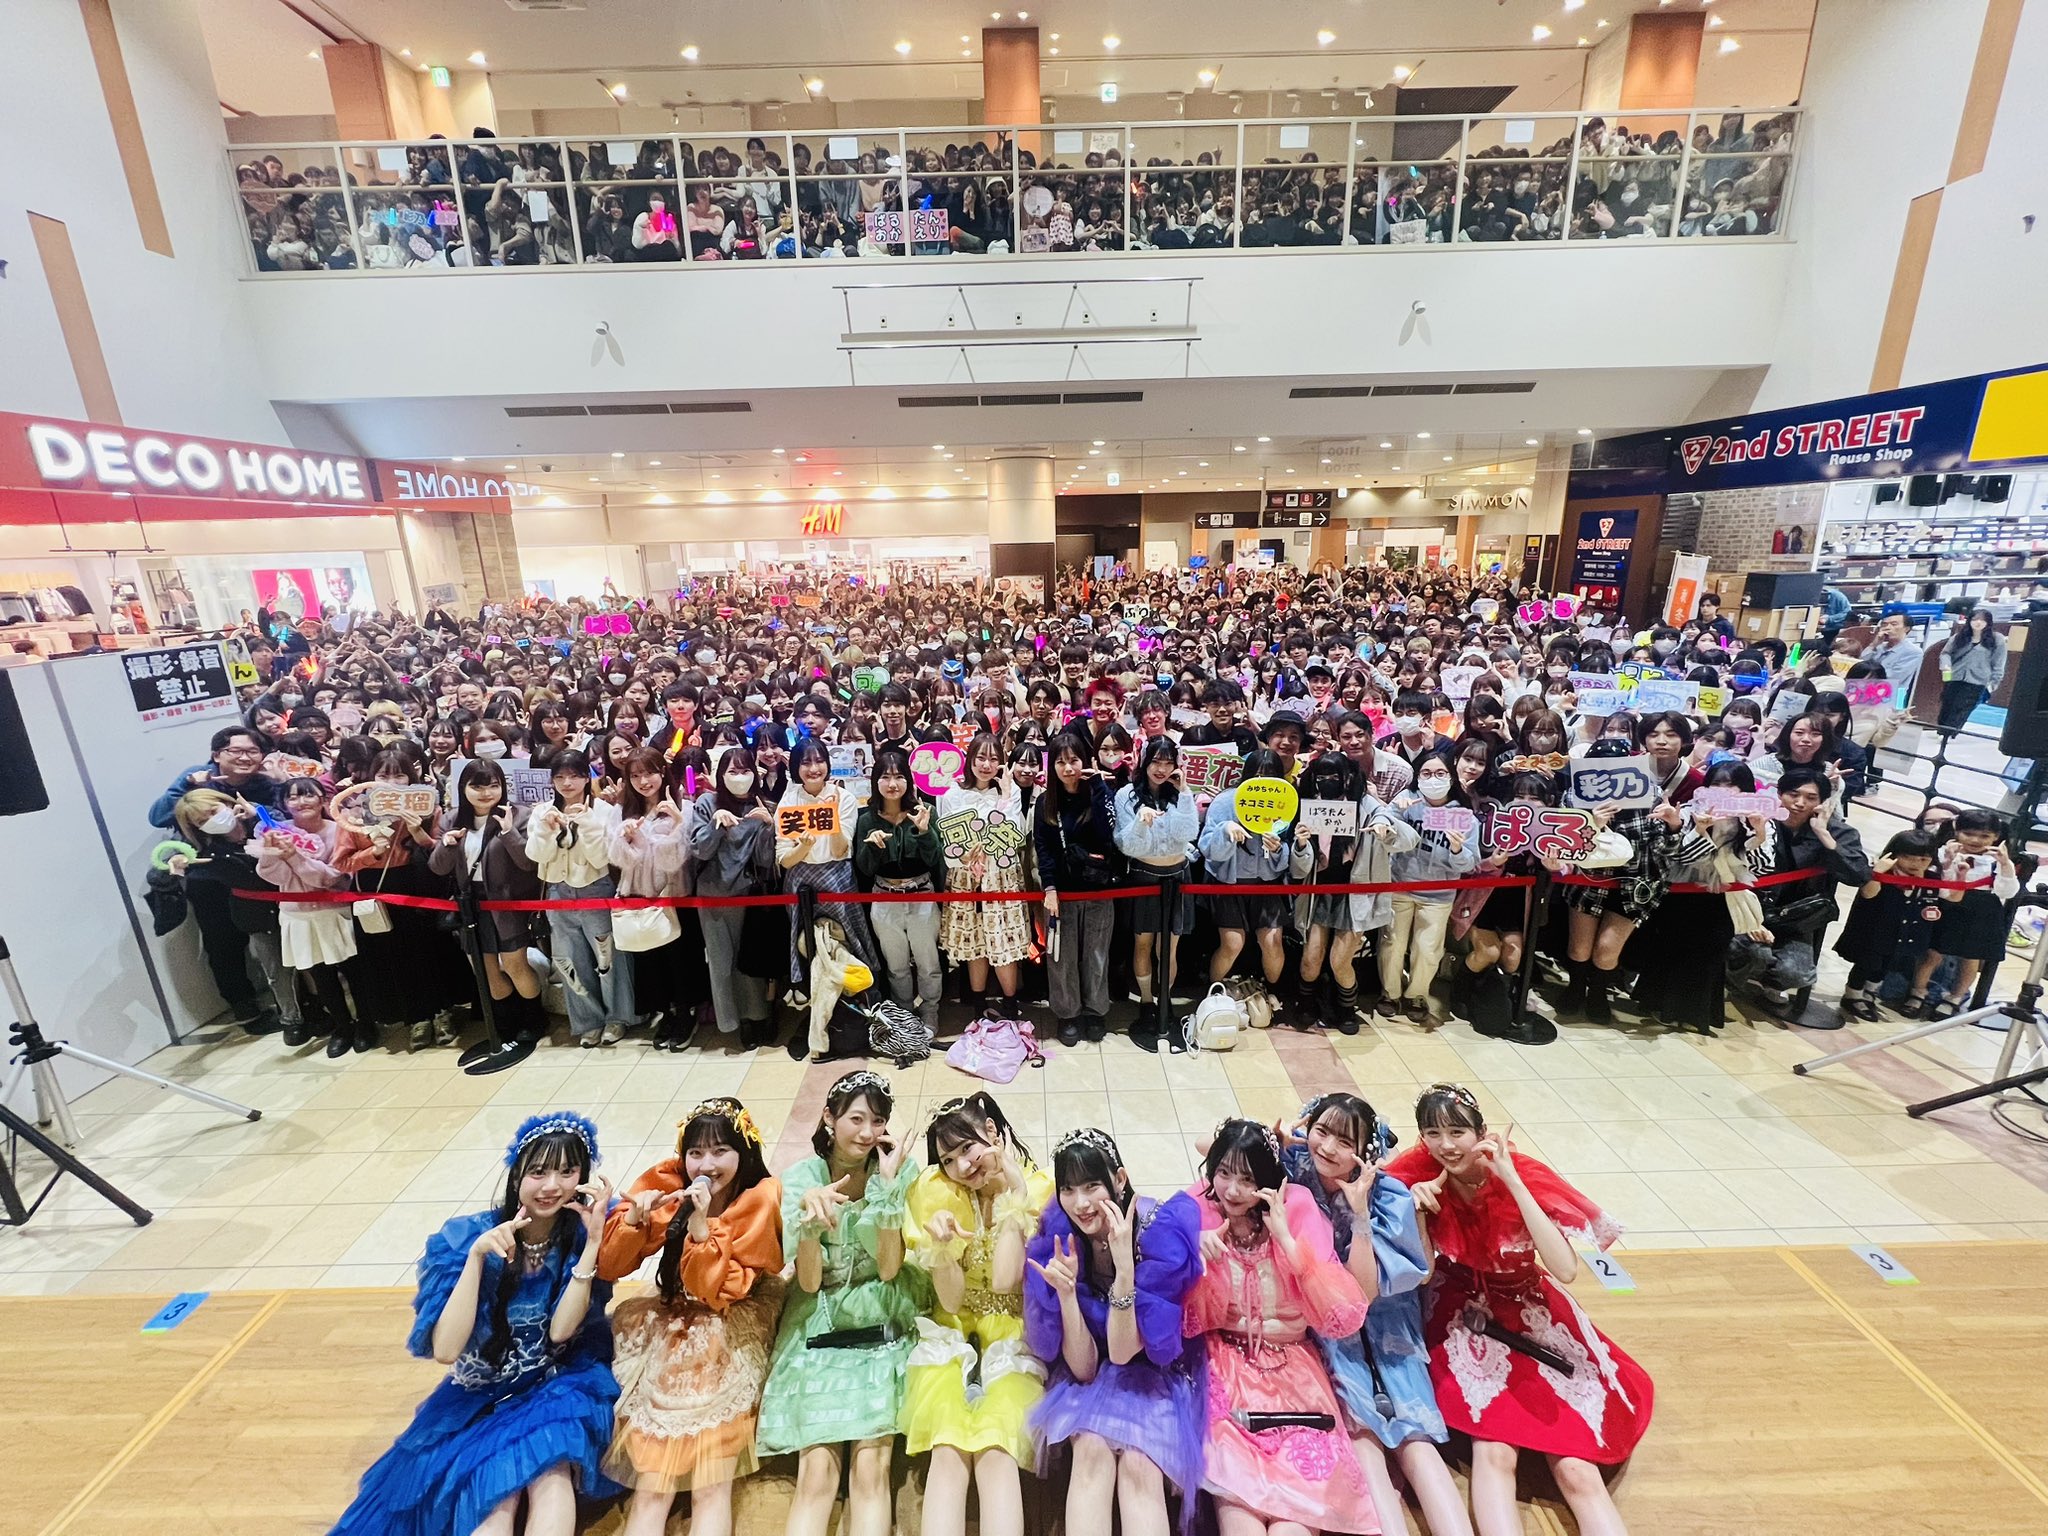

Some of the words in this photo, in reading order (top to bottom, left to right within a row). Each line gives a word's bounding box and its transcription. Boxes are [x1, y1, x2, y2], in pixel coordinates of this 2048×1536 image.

[1709, 430, 1770, 466] 2nd
[1774, 406, 1925, 456] STREET
[27, 423, 222, 489] DECO
[228, 447, 365, 499] HOME
[1829, 452, 1870, 466] Reuse
[1875, 448, 1913, 463] Shop
[800, 504, 842, 535] H&M
[1596, 538, 1632, 550] STREET
[126, 648, 220, 680] 撮影・録音
[235, 665, 252, 680] ん
[156, 674, 210, 704] 禁止
[1577, 771, 1646, 799] 彩乃
[374, 793, 430, 812] 笑瑠
[1238, 798, 1275, 809] ネコミミ
[781, 807, 834, 835] 笑瑠
[1245, 813, 1261, 823] して
[1325, 818, 1342, 826] おか
[1482, 803, 1587, 852] ぱる
[1559, 849, 1586, 860] たん
[1595, 1258, 1617, 1277] 2
[1868, 1252, 1894, 1271] 3
[163, 1301, 189, 1321] 3
